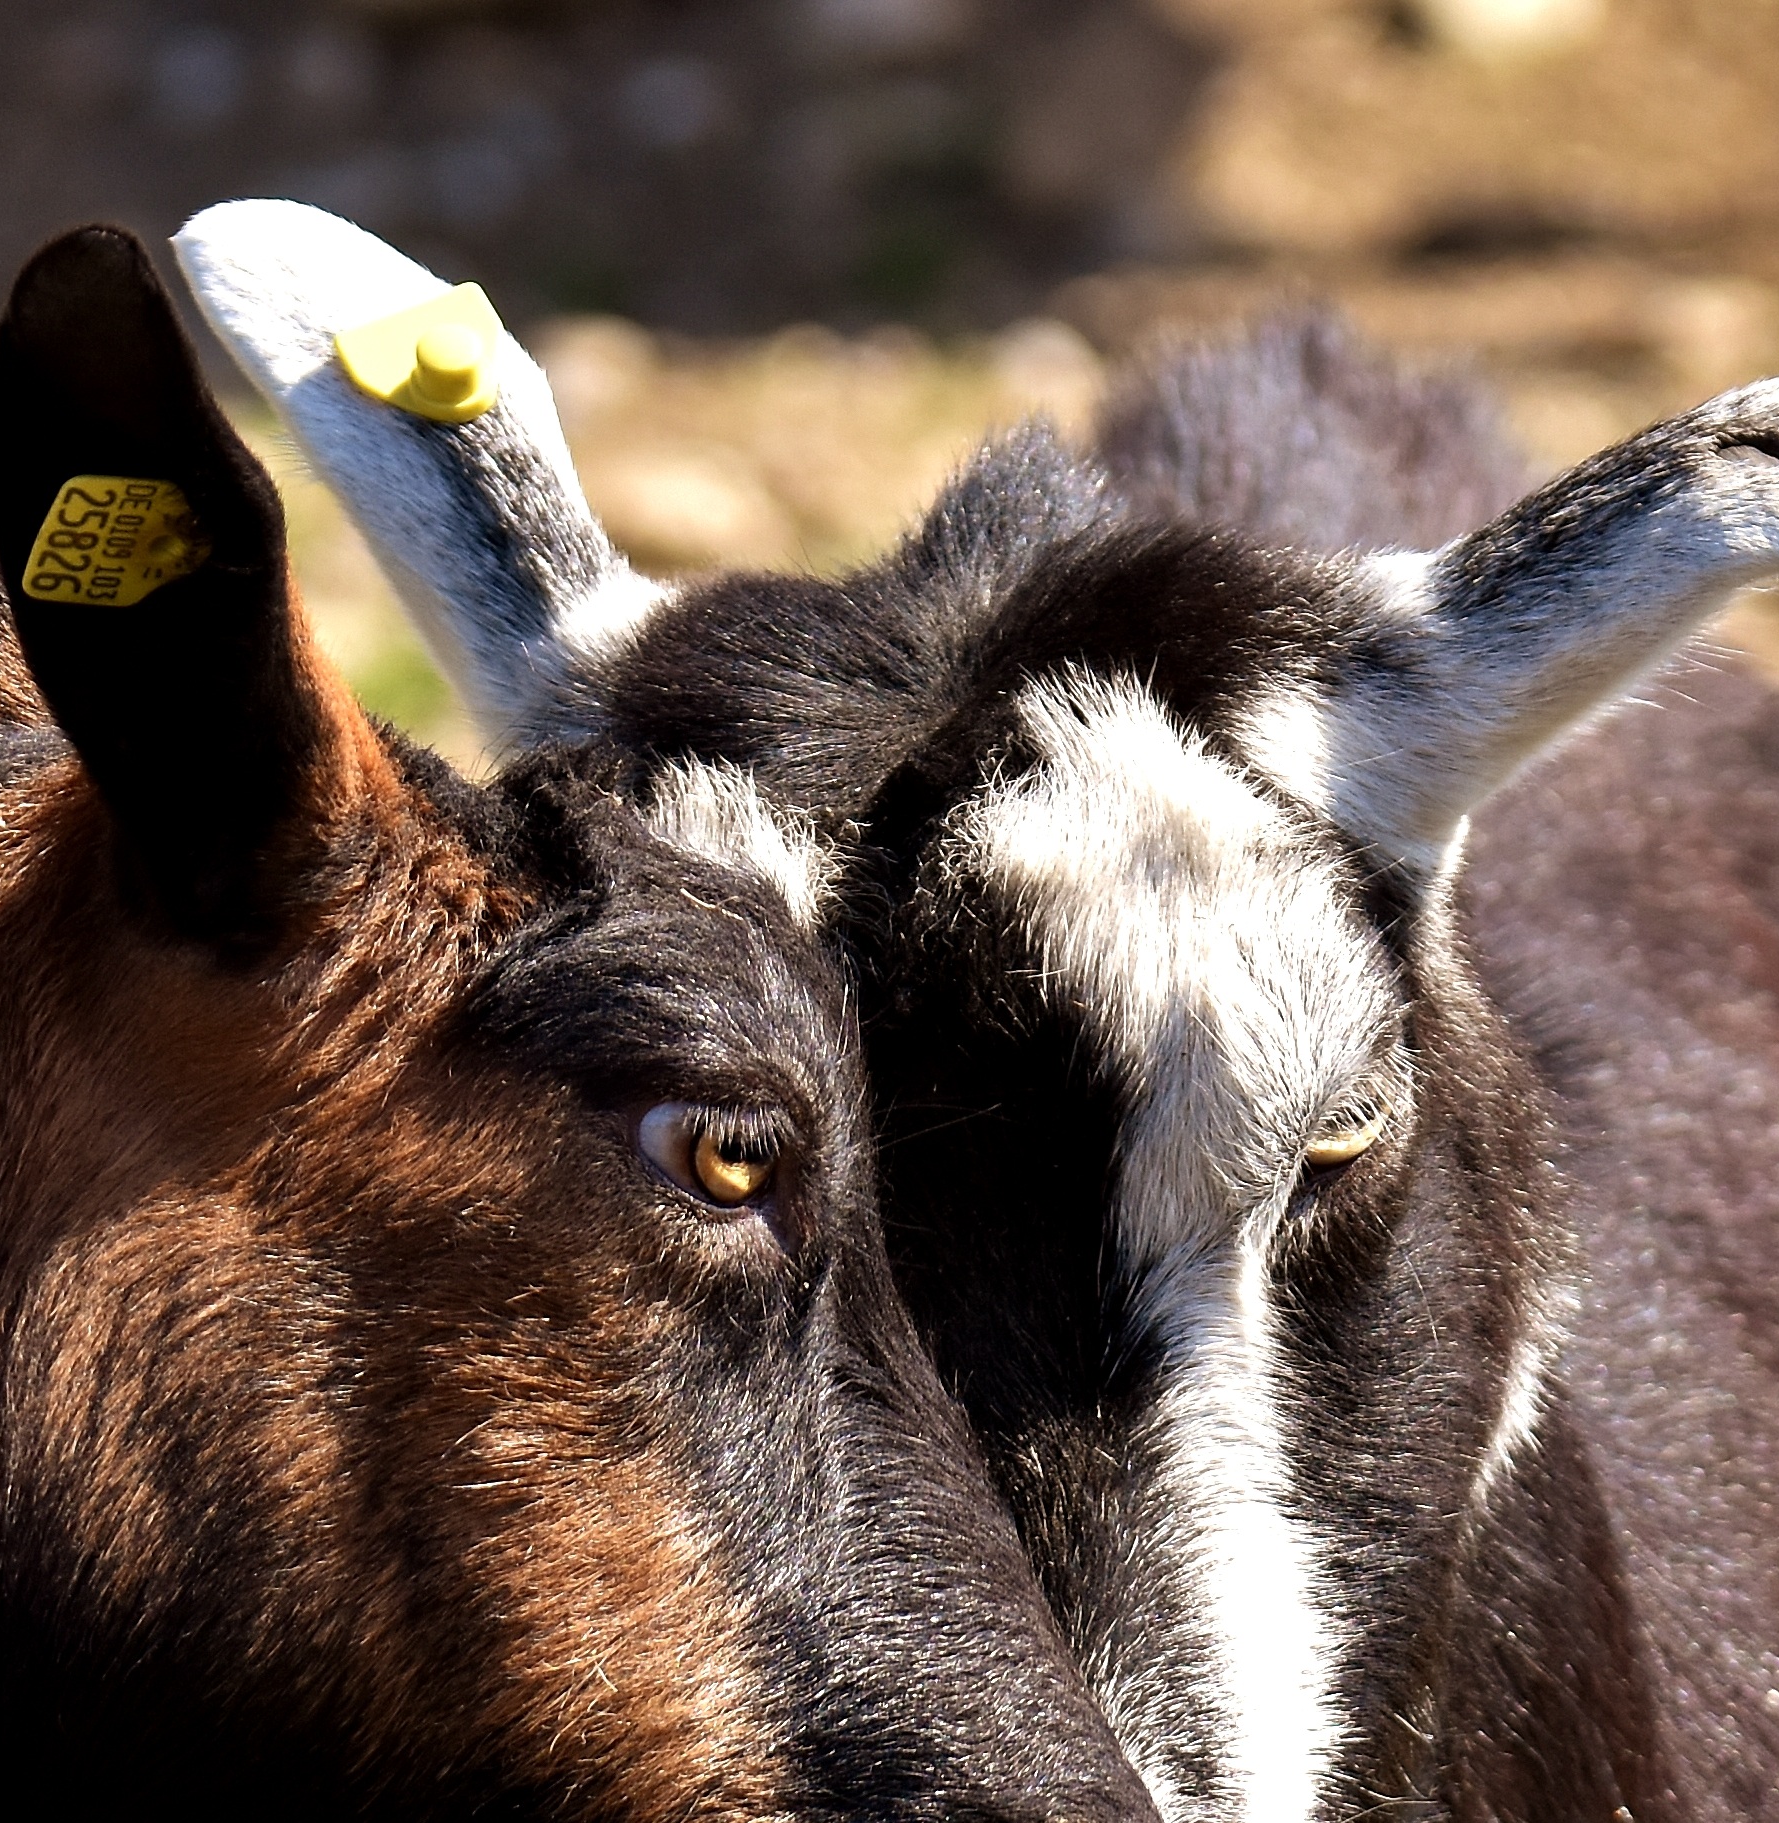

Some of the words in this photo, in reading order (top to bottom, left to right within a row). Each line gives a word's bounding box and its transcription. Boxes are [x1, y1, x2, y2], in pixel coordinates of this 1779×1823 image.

[118, 484, 158, 511] DE
[30, 486, 117, 594] 25826
[102, 514, 145, 559] 0109
[86, 564, 125, 600] 103
